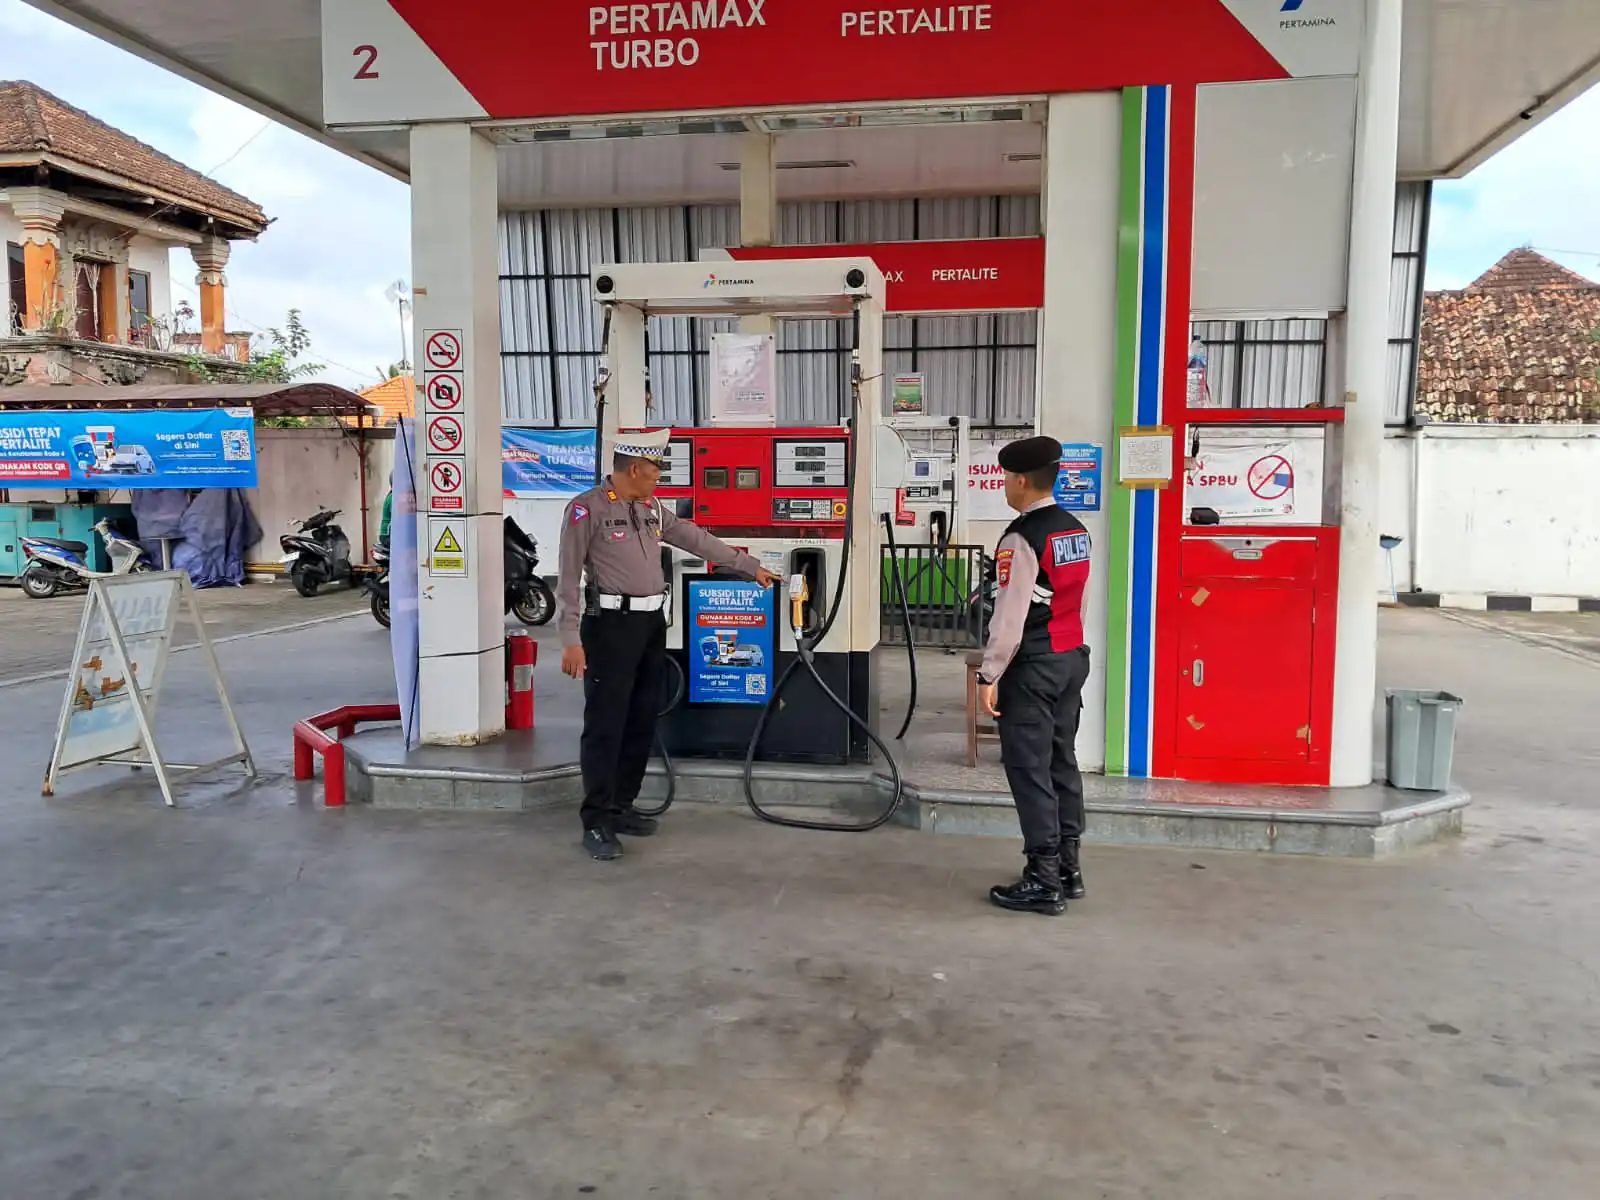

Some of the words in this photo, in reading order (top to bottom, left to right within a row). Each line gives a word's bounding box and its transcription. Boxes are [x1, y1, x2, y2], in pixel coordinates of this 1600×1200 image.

[590, 0, 766, 35] PERTAMAX
[841, 5, 991, 36] PERTALITE
[1280, 18, 1336, 28] PERTAMINA
[590, 38, 700, 71] TURBO
[353, 44, 379, 79] 2
[932, 268, 998, 281] PERTALITE
[26, 426, 61, 439] TEPAT
[155, 433, 185, 442] Segera
[187, 432, 213, 440] Daftar
[1199, 475, 1238, 486] SPBU
[699, 589, 735, 598] SUBSIDI
[735, 589, 764, 598] TEPAT
[709, 597, 754, 606] PERTALITE
